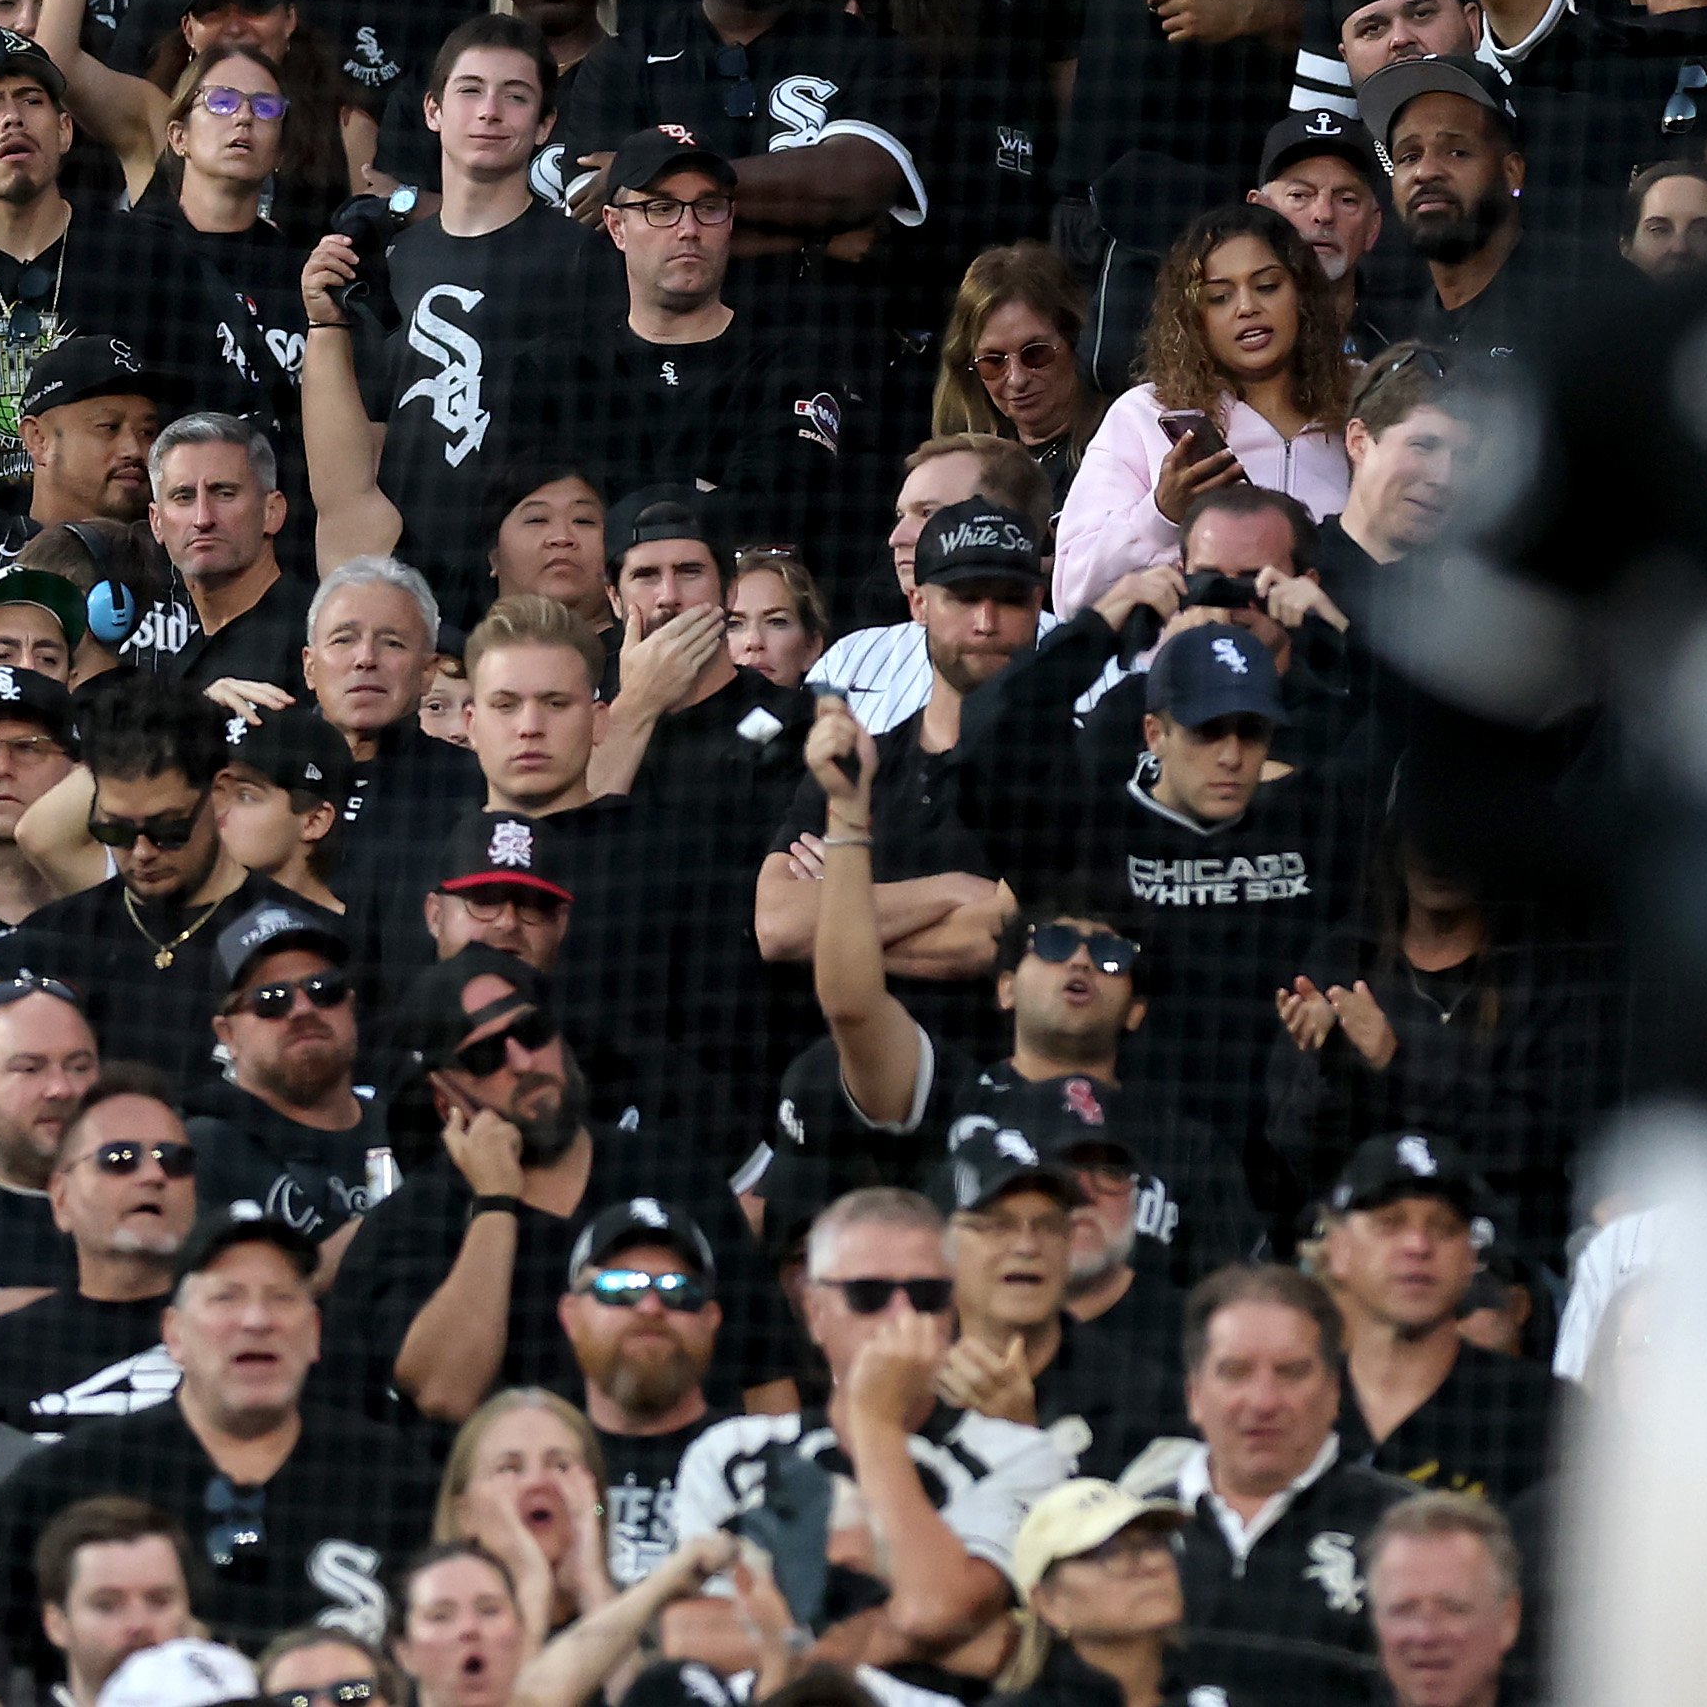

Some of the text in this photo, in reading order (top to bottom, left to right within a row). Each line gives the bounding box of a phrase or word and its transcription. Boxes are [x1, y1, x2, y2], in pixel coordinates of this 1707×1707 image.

[398, 283, 491, 468] Sox
[939, 523, 999, 556] White
[1128, 852, 1307, 884] CHICAGO
[1130, 874, 1313, 906] WHITE SOX
